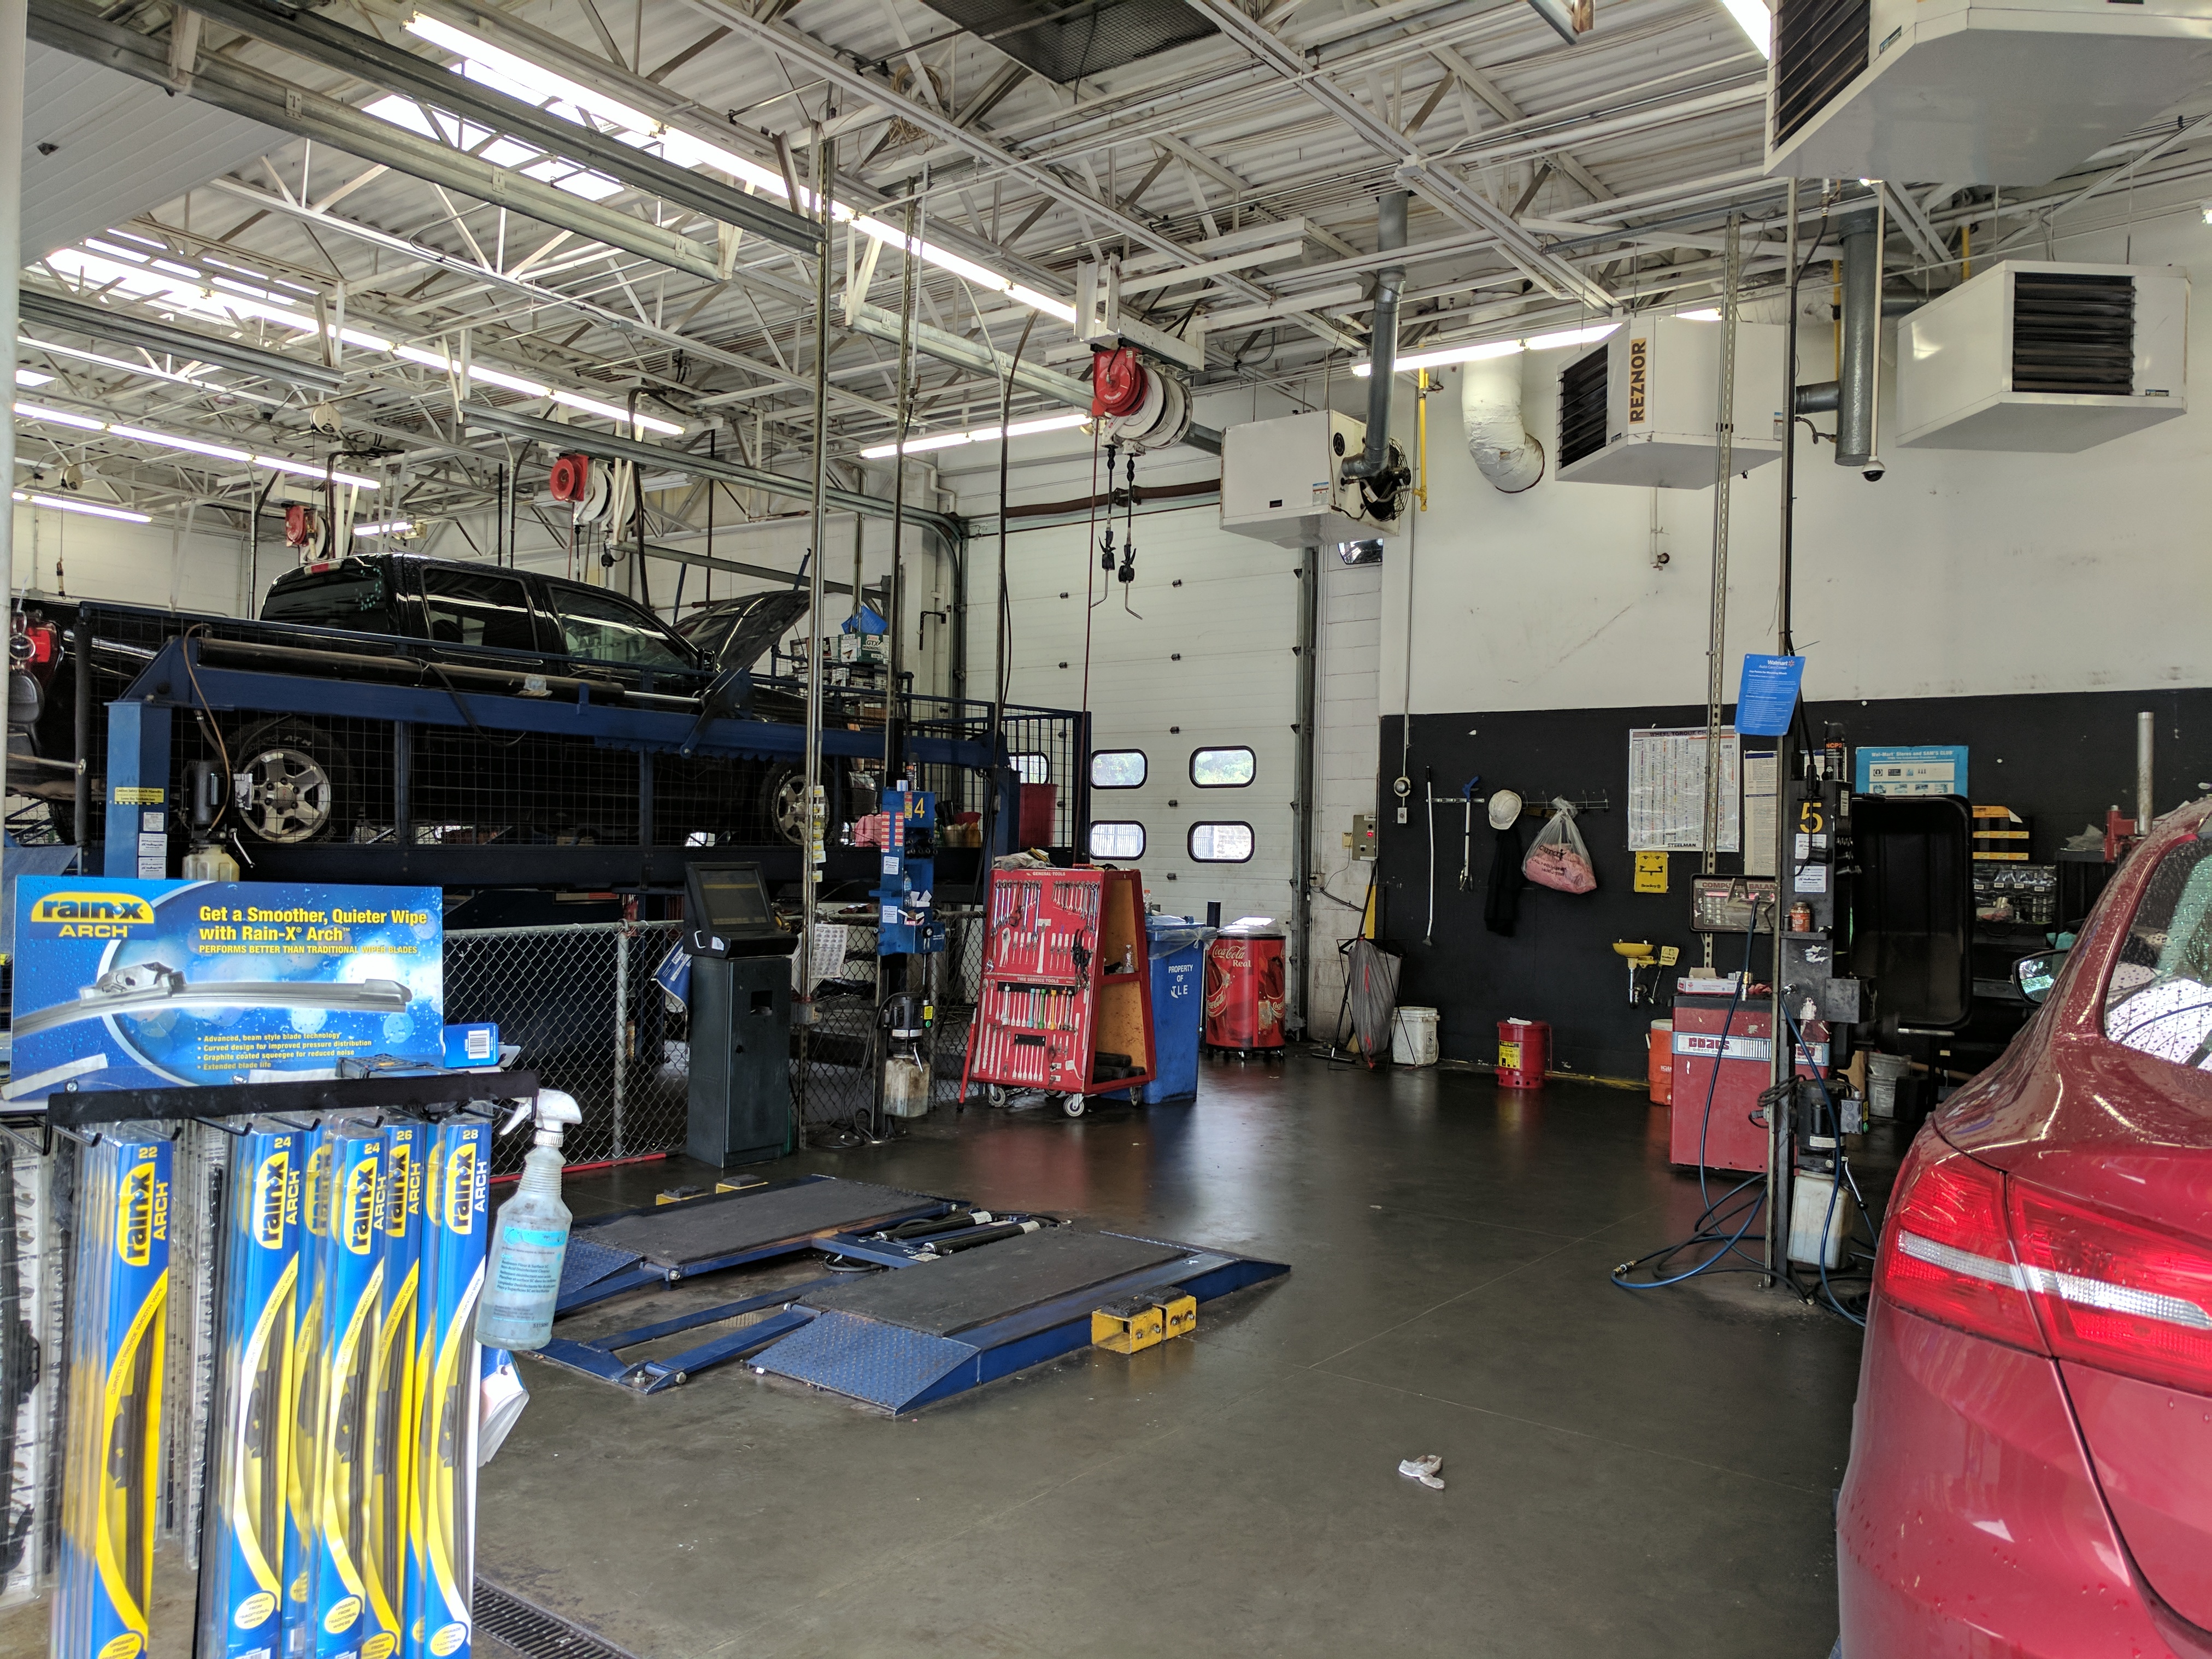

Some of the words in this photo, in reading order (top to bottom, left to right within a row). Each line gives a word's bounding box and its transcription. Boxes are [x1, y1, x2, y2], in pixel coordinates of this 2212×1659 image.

[1630, 340, 1646, 422] REZNOR
[914, 797, 925, 819] 4
[1799, 802, 1823, 833] 5
[200, 905, 228, 921] Get
[232, 909, 242, 921] a
[248, 907, 328, 925] Smoother,
[332, 908, 387, 925] Quieter
[391, 909, 427, 927] Wipe
[58, 925, 128, 938] ARCH
[199, 925, 237, 940] with
[199, 945, 246, 954] PERFORMS
[249, 945, 280, 954] BETTER
[283, 945, 304, 954] THAN
[1212, 945, 1248, 960] Coca-Cola
[1168, 964, 1193, 973] PROPERTY
[1176, 974, 1184, 983] OF
[396, 1129, 413, 1141] 26
[463, 1129, 479, 1140] 28
[274, 1137, 292, 1149] 24
[364, 1142, 380, 1155] 24
[139, 1146, 158, 1160] 22
[408, 1162, 421, 1214] ARCH
[474, 1161, 487, 1213] ARCH
[286, 1170, 300, 1225] ARCH
[374, 1176, 387, 1230] ARCH
[154, 1182, 168, 1240] ARCH
[270, 1285, 285, 1310] SMOOTH
[284, 1270, 295, 1284] WIPE
[404, 1280, 414, 1295] WIPE
[472, 1278, 481, 1291] WIPE
[358, 1290, 373, 1315] SMOOTH
[372, 1274, 380, 1289] WIPE
[111, 1369, 122, 1395] CURVED
[119, 1358, 126, 1368] TO
[123, 1331, 138, 1358] PROVIDE
[136, 1304, 153, 1331] SMOOTH
[151, 1287, 163, 1303] WIPE
[246, 1596, 269, 1606] UPGRADE
[336, 1599, 356, 1611] UPGRADE
[239, 1608, 270, 1620] TRADITIONAL
[338, 1607, 351, 1615] FROM
[244, 1615, 263, 1625] WIPERS
[328, 1612, 357, 1624] TRADITIONAL
[333, 1619, 351, 1629] WIPERS
